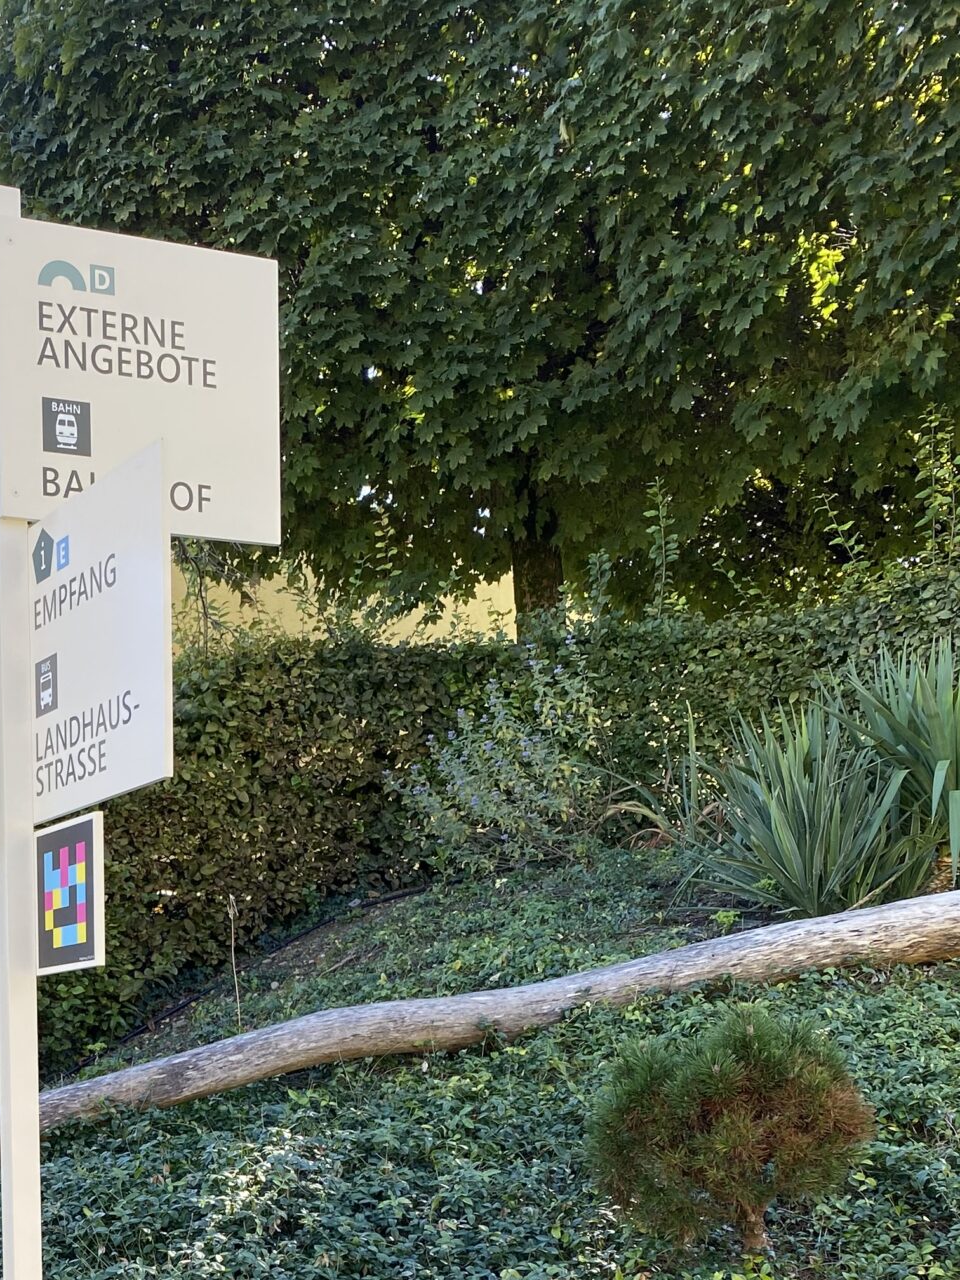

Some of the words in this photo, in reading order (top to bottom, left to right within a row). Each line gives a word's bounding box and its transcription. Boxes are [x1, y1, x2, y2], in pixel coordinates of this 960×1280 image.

[94, 269, 110, 290] D
[39, 301, 186, 351] EXTERNE
[37, 337, 217, 389] ANGEBOTE
[51, 401, 81, 415] BAHN
[42, 466, 212, 513] BAOF
[34, 553, 117, 631] EMPFANG
[41, 660, 51, 674] BUS
[35, 688, 141, 762] LANDHAUS-
[35, 739, 107, 798] STRASSE
